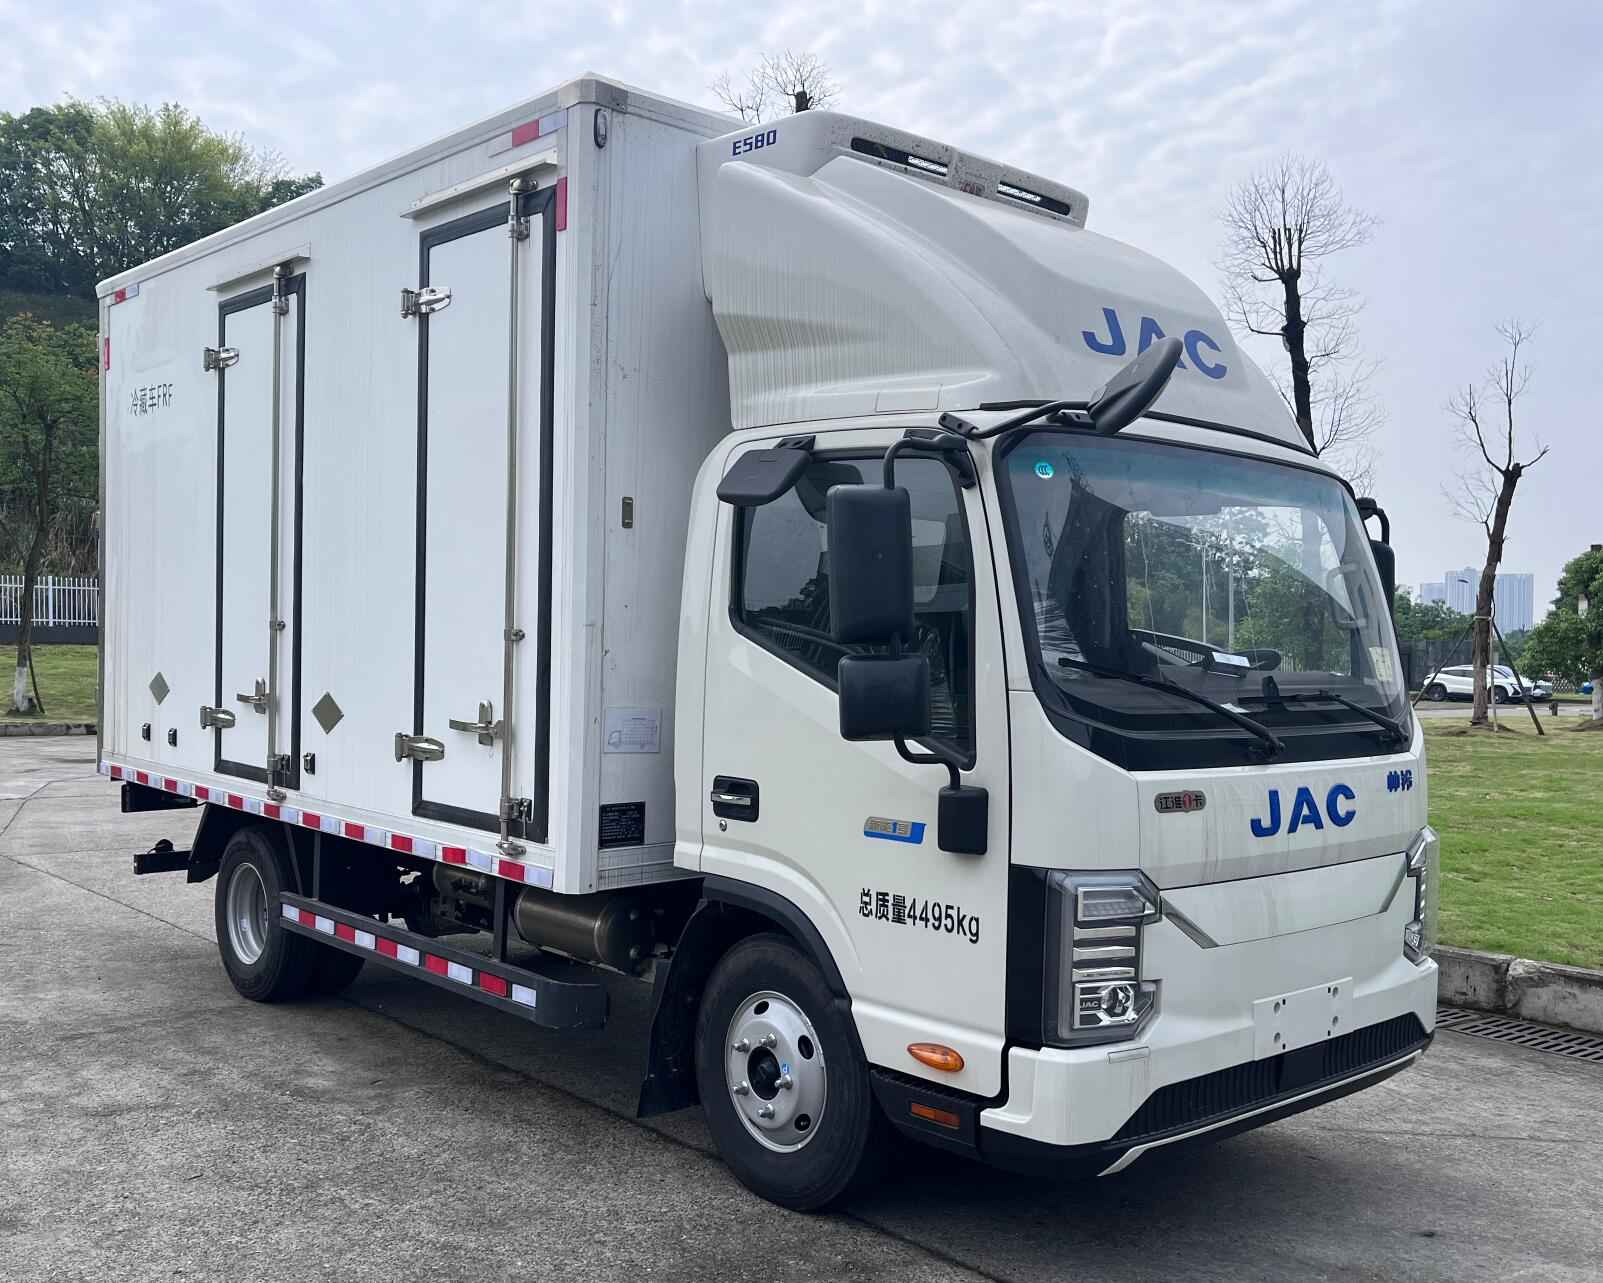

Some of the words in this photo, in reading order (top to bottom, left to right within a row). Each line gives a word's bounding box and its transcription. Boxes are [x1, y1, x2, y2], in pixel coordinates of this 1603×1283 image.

[732, 129, 777, 157] E580
[1250, 783, 1357, 838] JAC
[858, 888, 980, 945] 总质量4495kg
[1080, 1000, 1099, 1009] JAC
